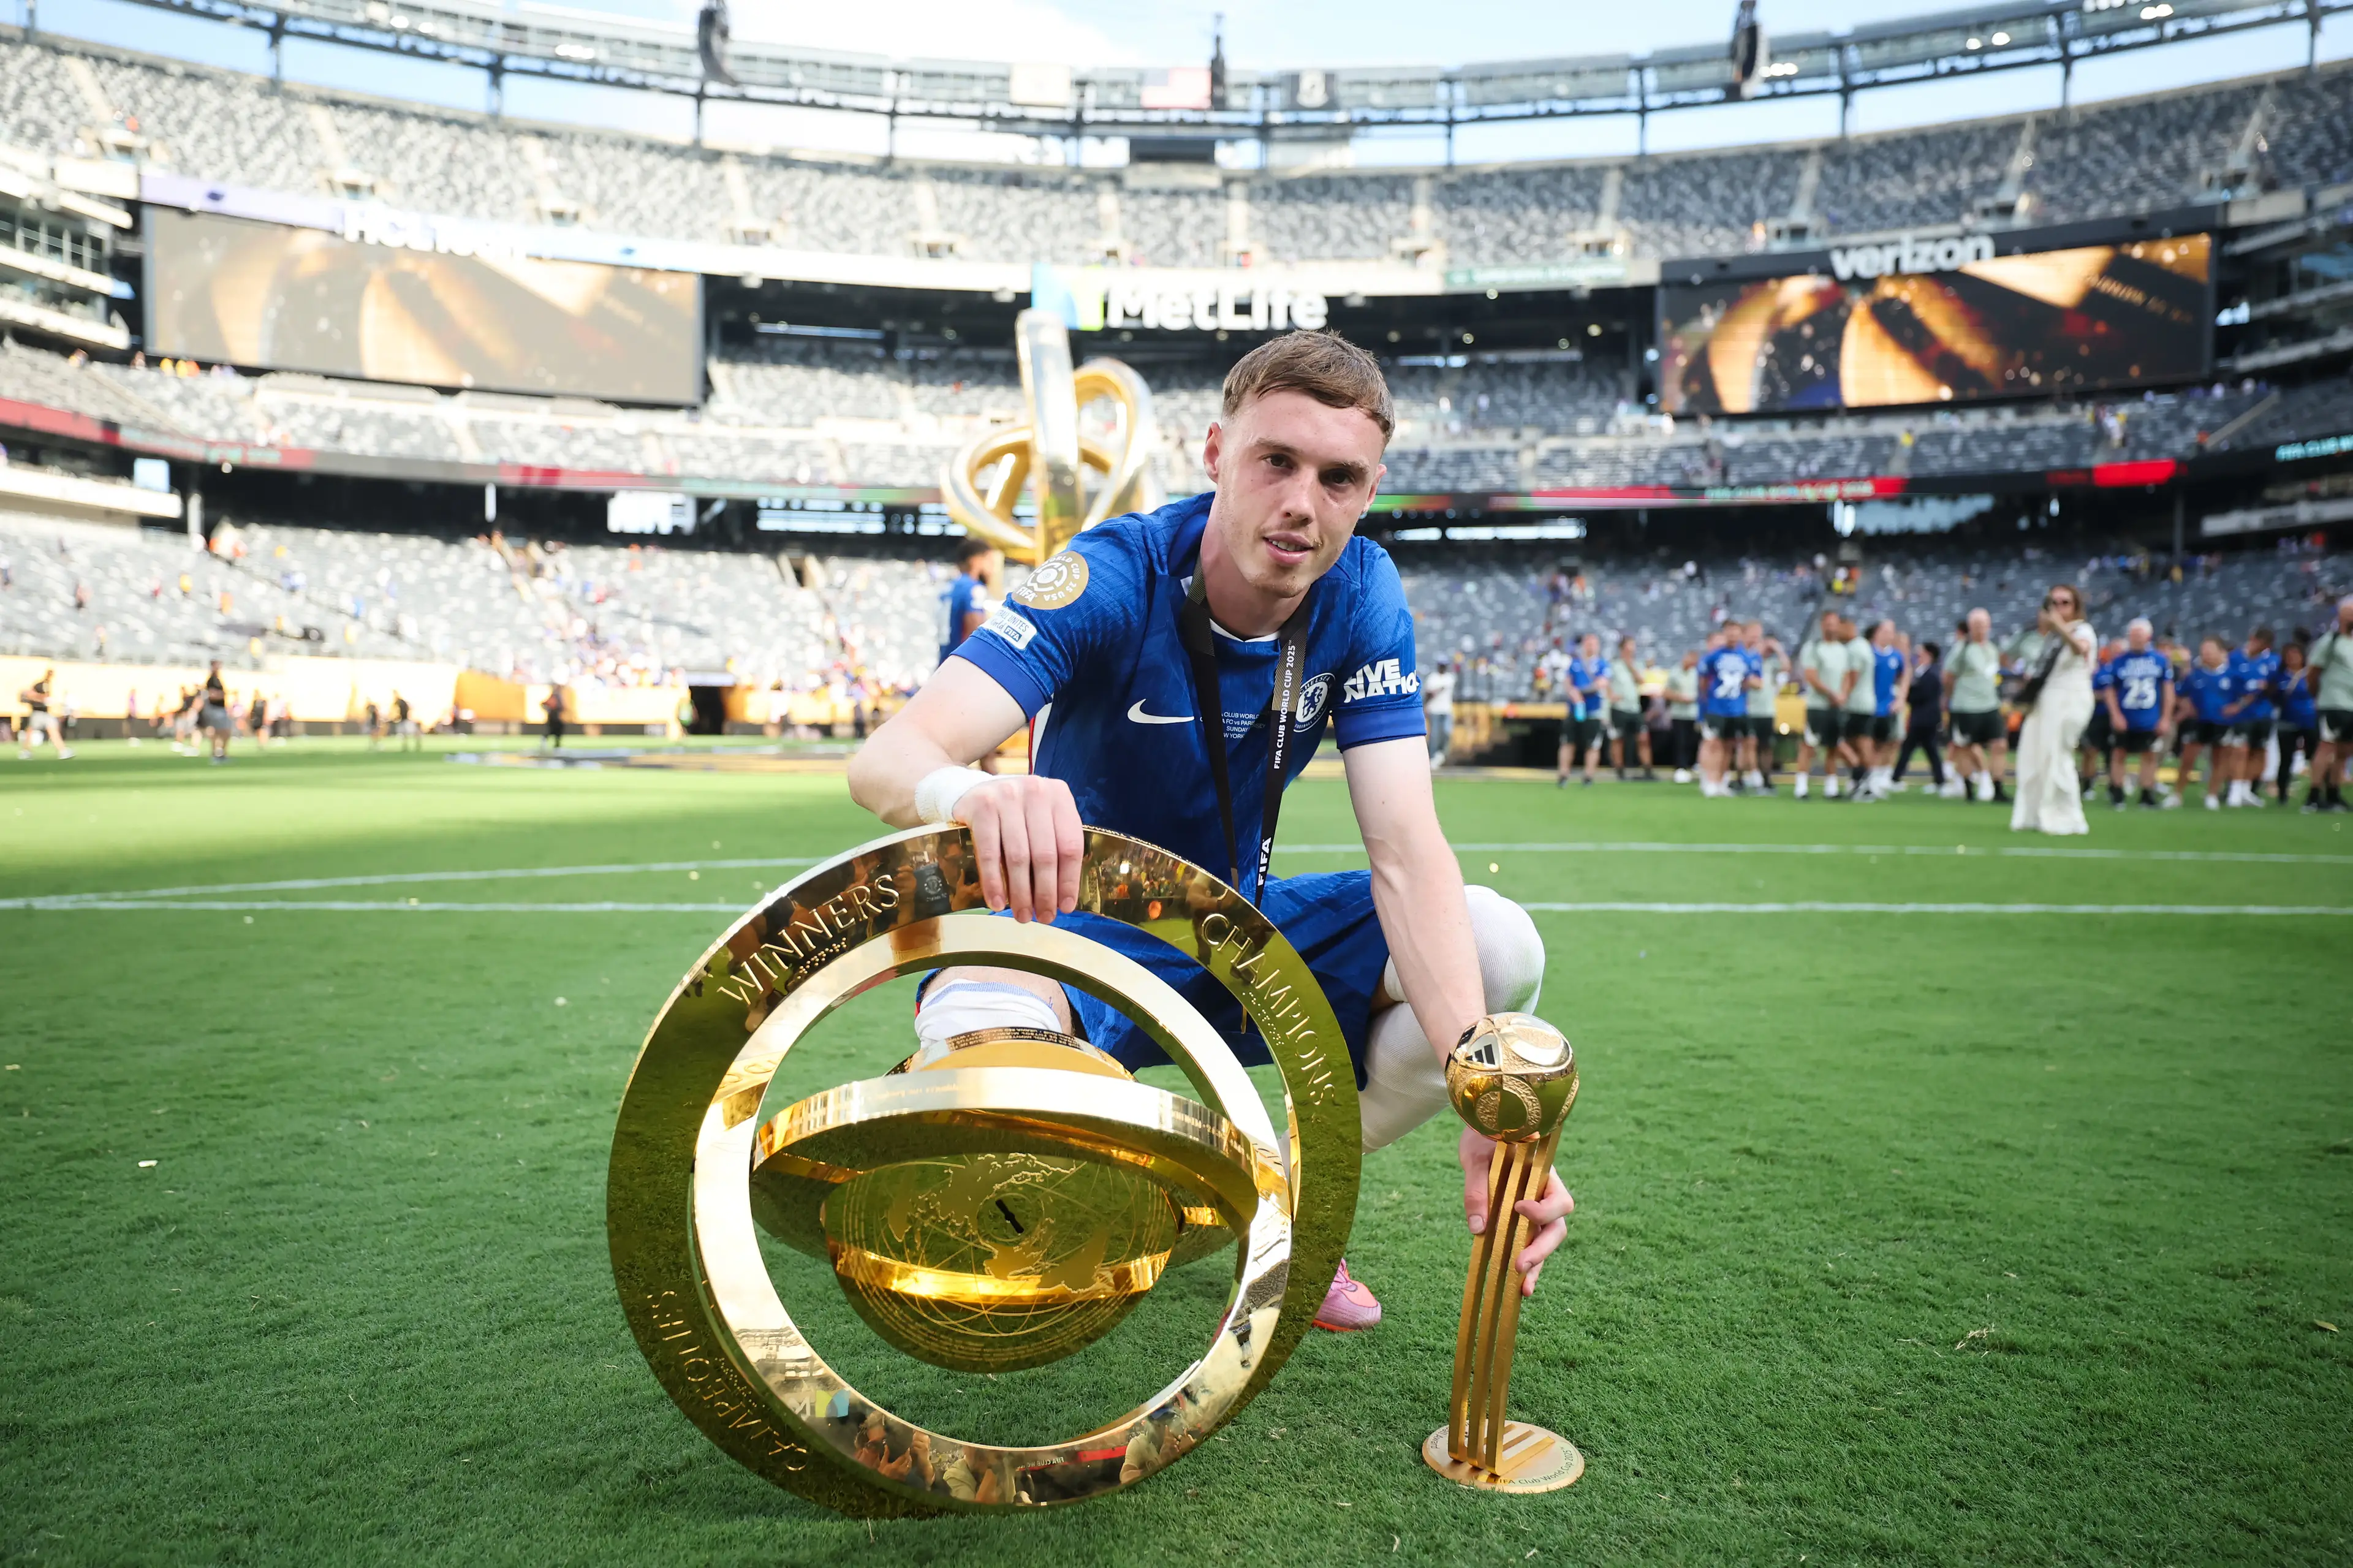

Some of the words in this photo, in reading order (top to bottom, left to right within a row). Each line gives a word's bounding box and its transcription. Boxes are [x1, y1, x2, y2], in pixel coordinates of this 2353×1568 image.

[1830, 233, 1995, 281] verizon
[1106, 286, 1328, 330] MetLife
[1071, 563, 1080, 580] CUP
[1016, 586, 1037, 602] FIFA
[1043, 591, 1065, 601] USA
[1005, 626, 1021, 642] FIFA
[1008, 615, 1029, 632] UNITES
[1284, 669, 1292, 688] CUP
[1344, 658, 1401, 686] LIVE
[1279, 689, 1290, 723] WORLD
[1277, 725, 1286, 748] CLUB
[1257, 837, 1271, 886] FIFA
[716, 874, 900, 1006] WINNERS
[1201, 913, 1335, 1105] CHAMPIONS
[1540, 1471, 1564, 1481] World
[1561, 1462, 1574, 1473] Cup
